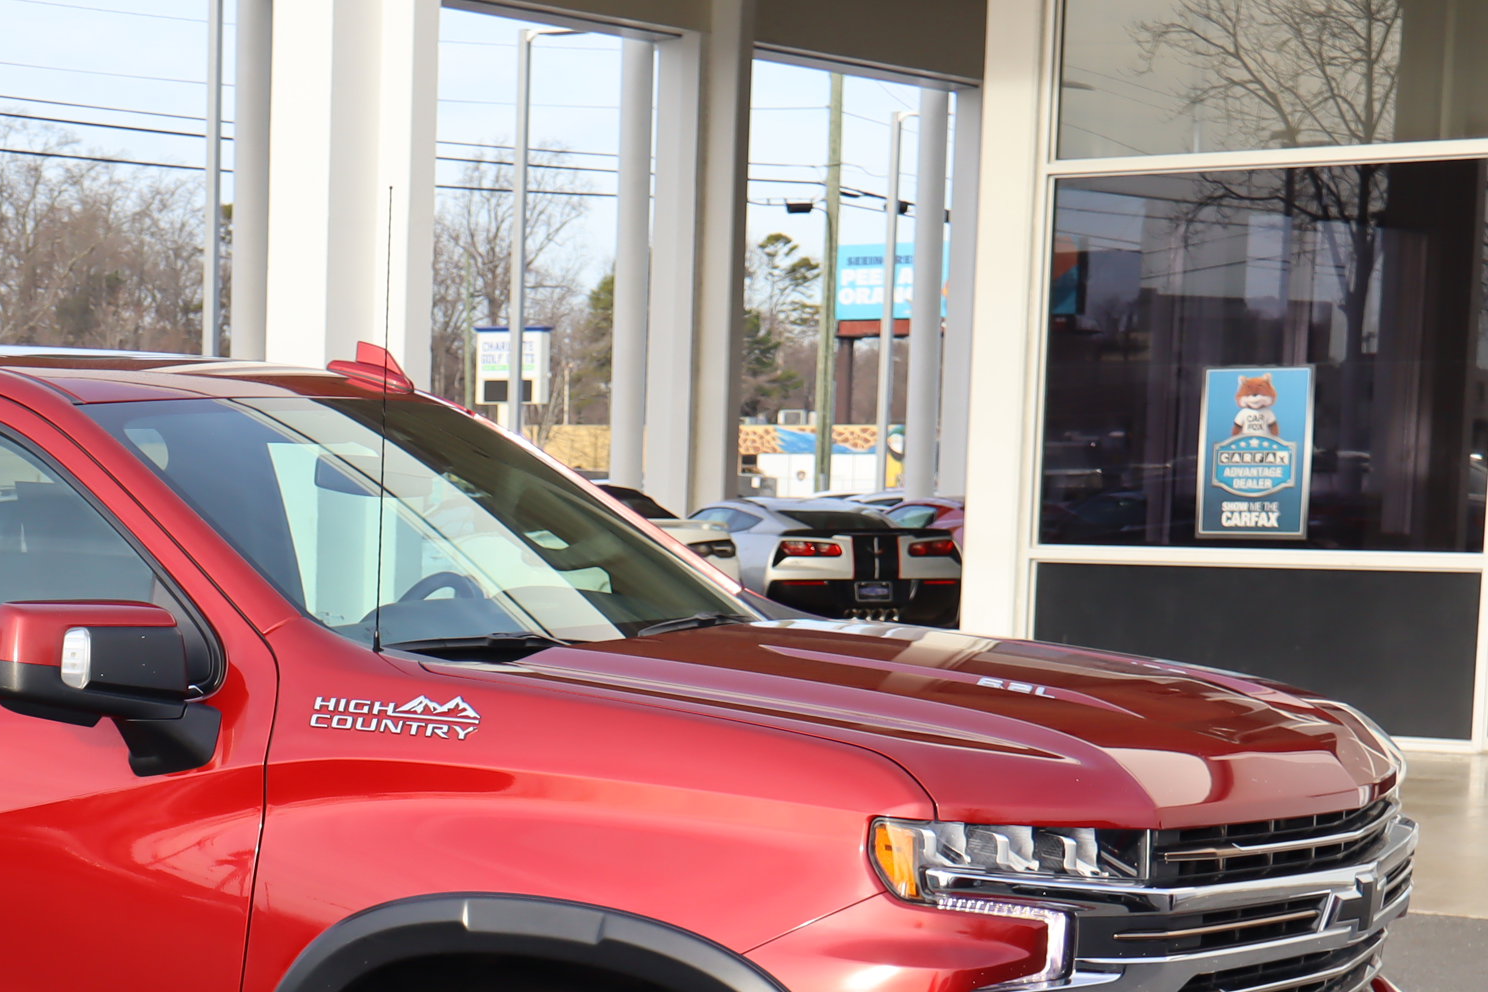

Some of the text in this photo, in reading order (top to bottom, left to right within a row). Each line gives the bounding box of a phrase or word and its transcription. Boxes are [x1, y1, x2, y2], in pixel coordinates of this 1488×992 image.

[846, 255, 885, 267] SEEIN
[841, 267, 885, 287] PEE
[1247, 414, 1265, 423] CAR
[1219, 452, 1290, 464] CARFAX
[1223, 467, 1283, 478] ADVANTAGE
[1233, 479, 1272, 489] DEALER
[1221, 502, 1279, 512] SHOW ME THE
[1221, 512, 1281, 528] CARFAX
[313, 696, 397, 717] HIGH
[310, 713, 479, 741] COUNTRY
